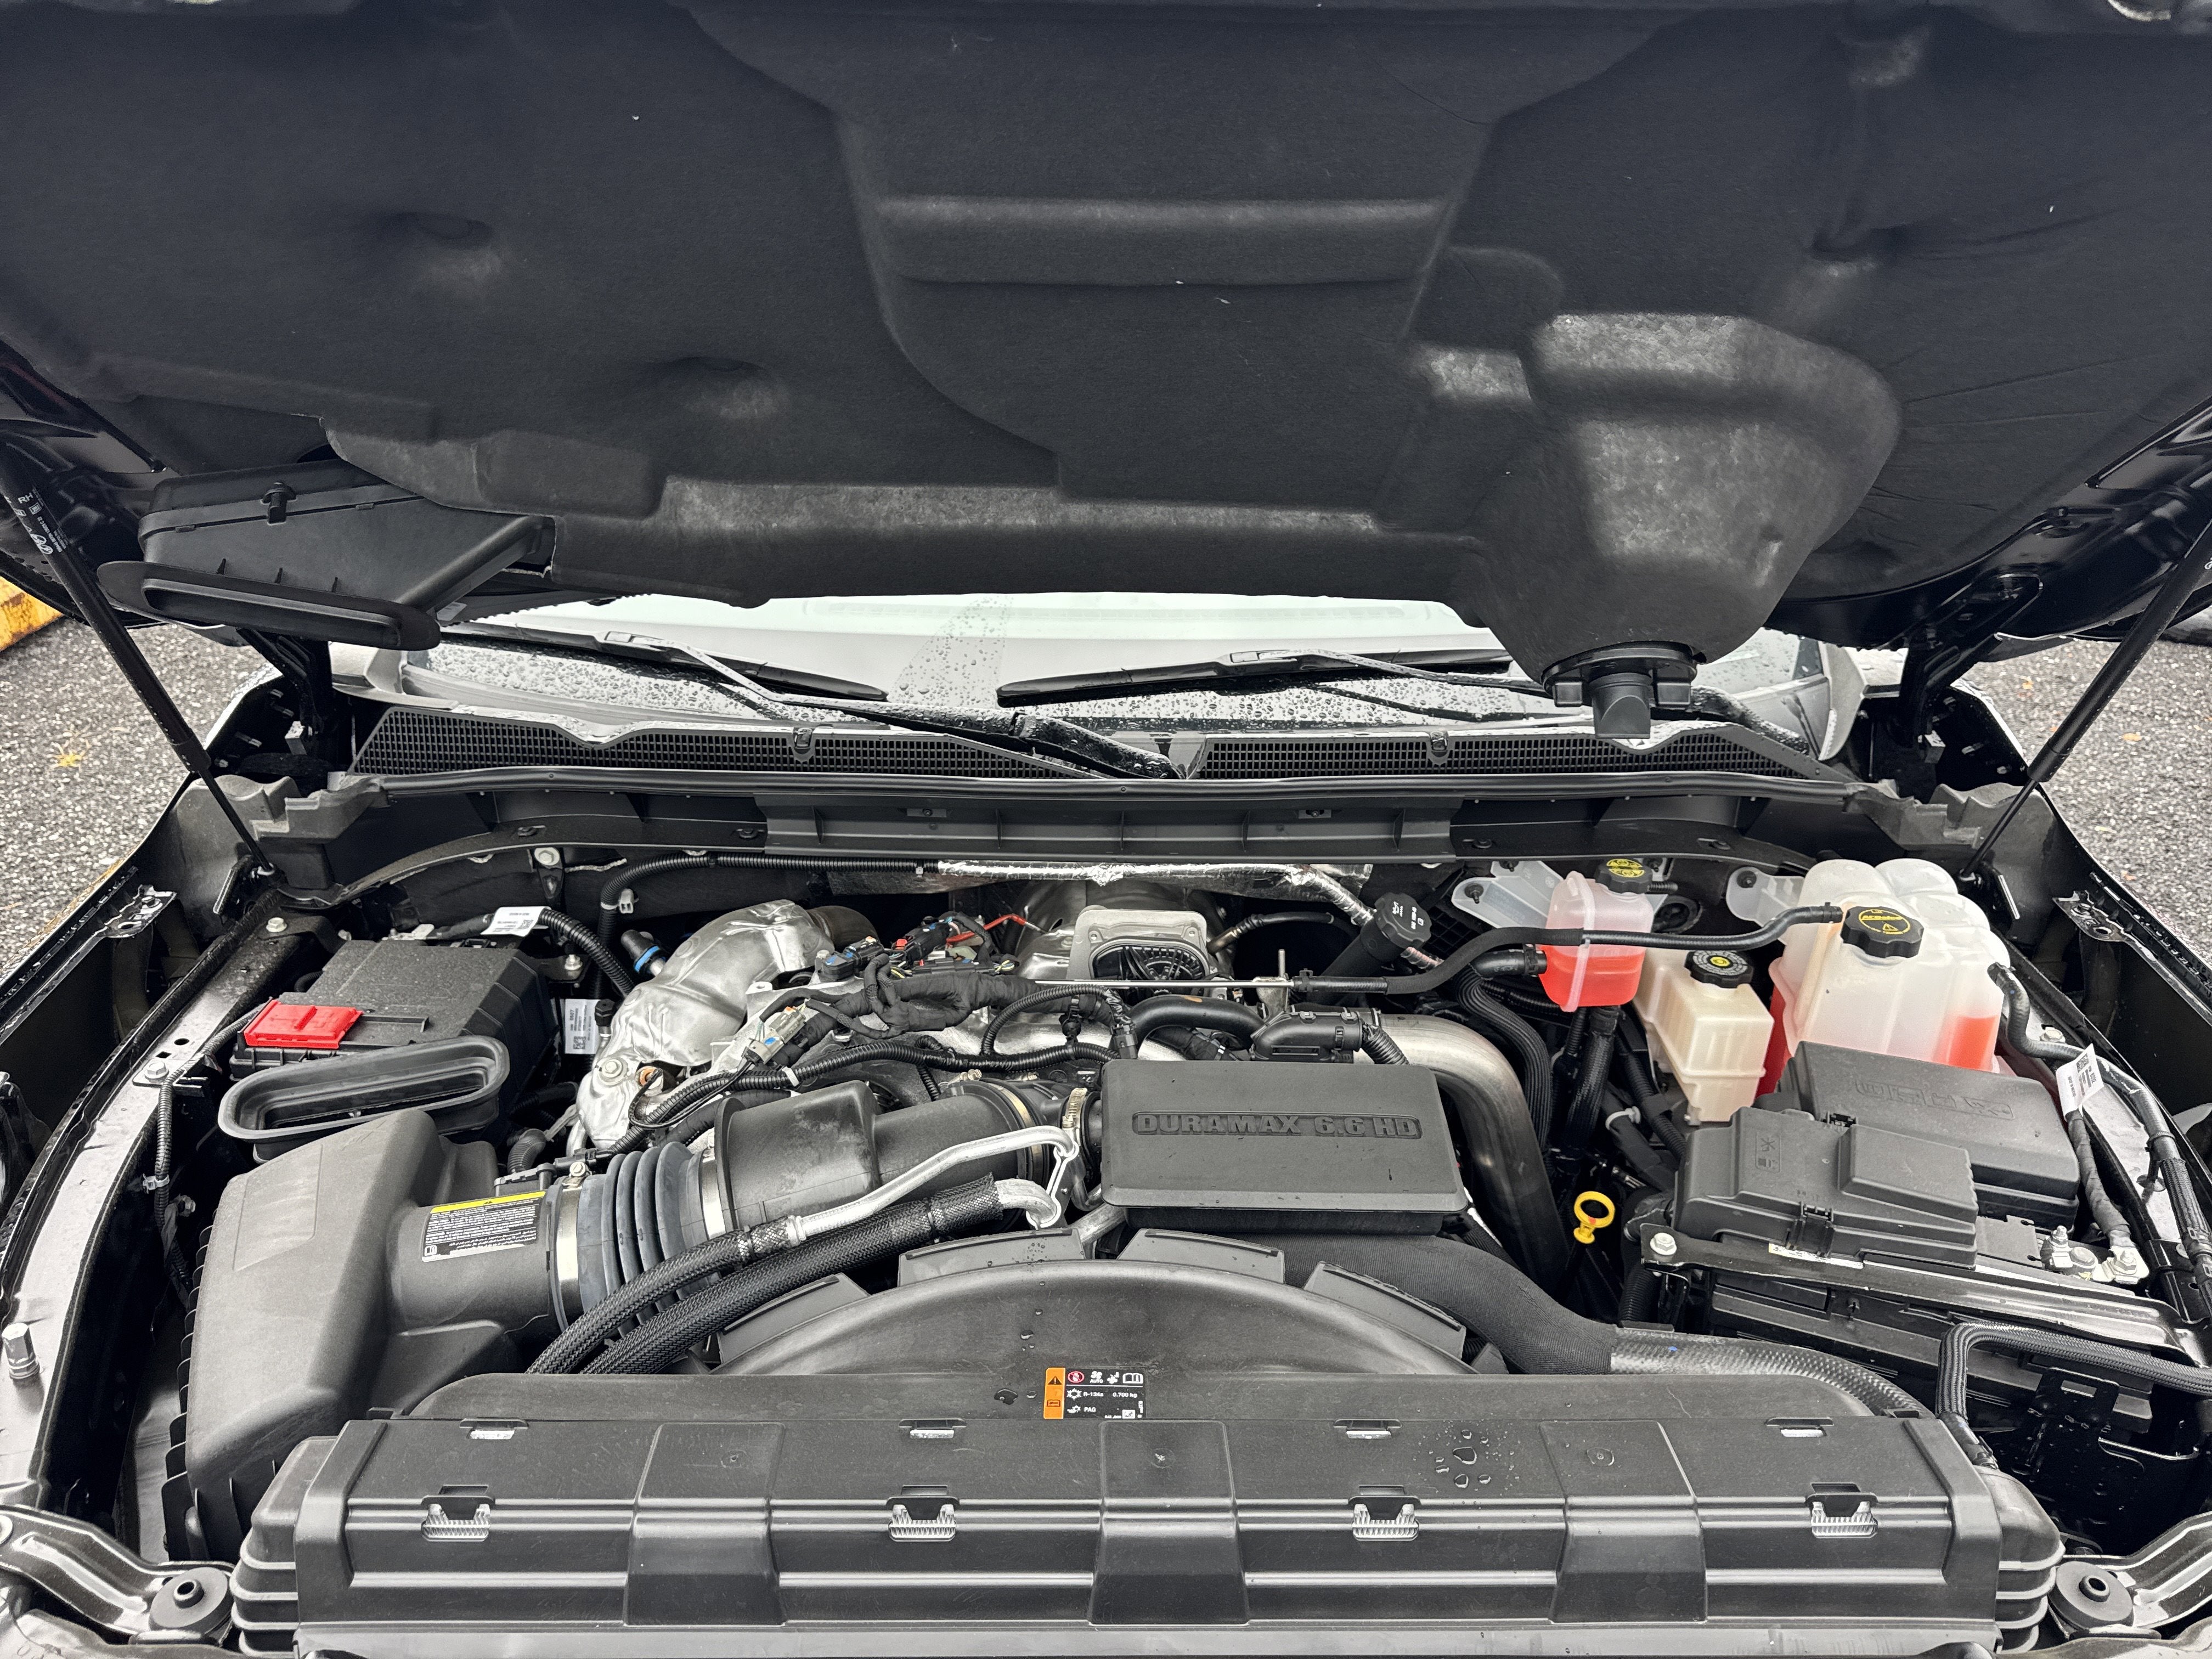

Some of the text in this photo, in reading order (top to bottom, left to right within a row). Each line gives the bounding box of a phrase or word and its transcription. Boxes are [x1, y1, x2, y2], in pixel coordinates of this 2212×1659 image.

[18, 492, 33, 504] RH
[1137, 1114, 1418, 1137] DURAMAX 6.6 HD
